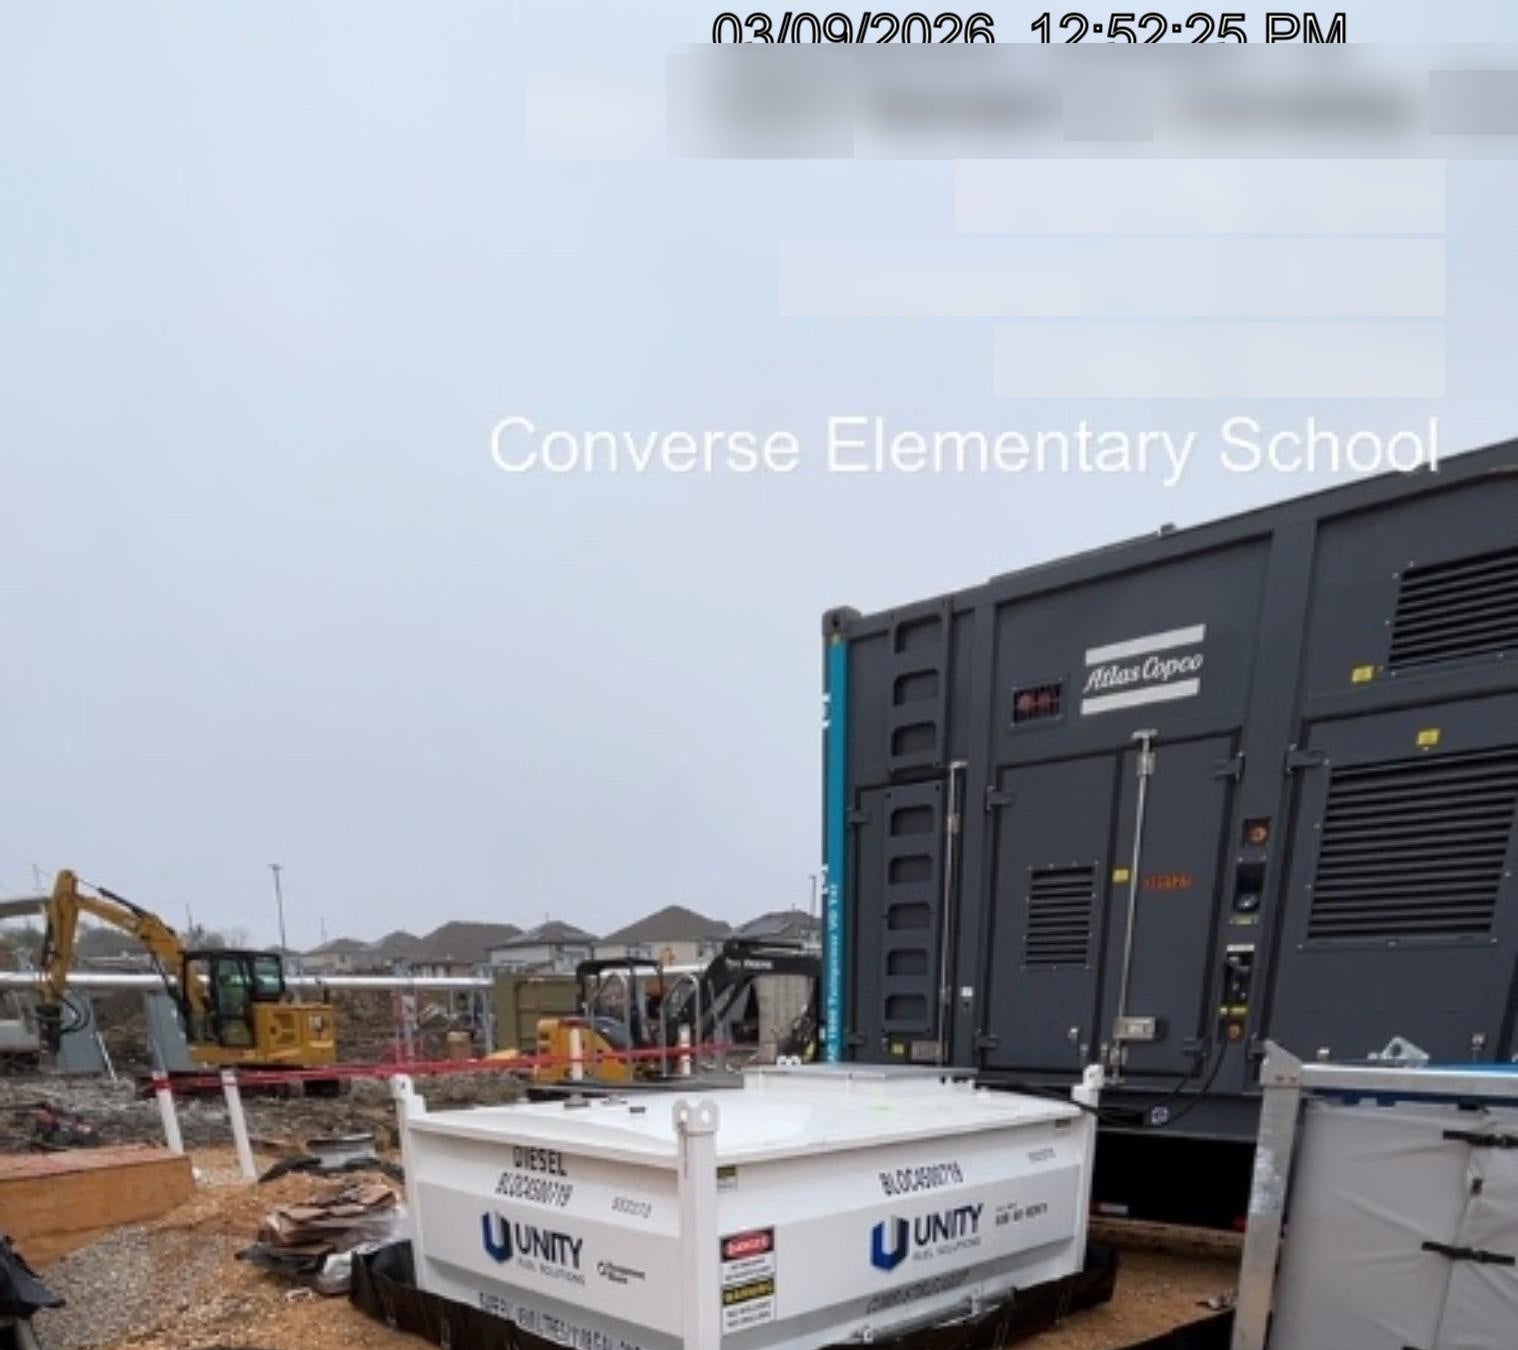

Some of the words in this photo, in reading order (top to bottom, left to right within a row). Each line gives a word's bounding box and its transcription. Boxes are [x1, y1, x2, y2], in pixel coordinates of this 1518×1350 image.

[1082, 665, 1141, 694] Atlas
[1143, 654, 1204, 681] Copco
[512, 1145, 567, 1177] DIESEL
[914, 1202, 984, 1247] UNITY
[515, 1222, 583, 1270] UNITY
